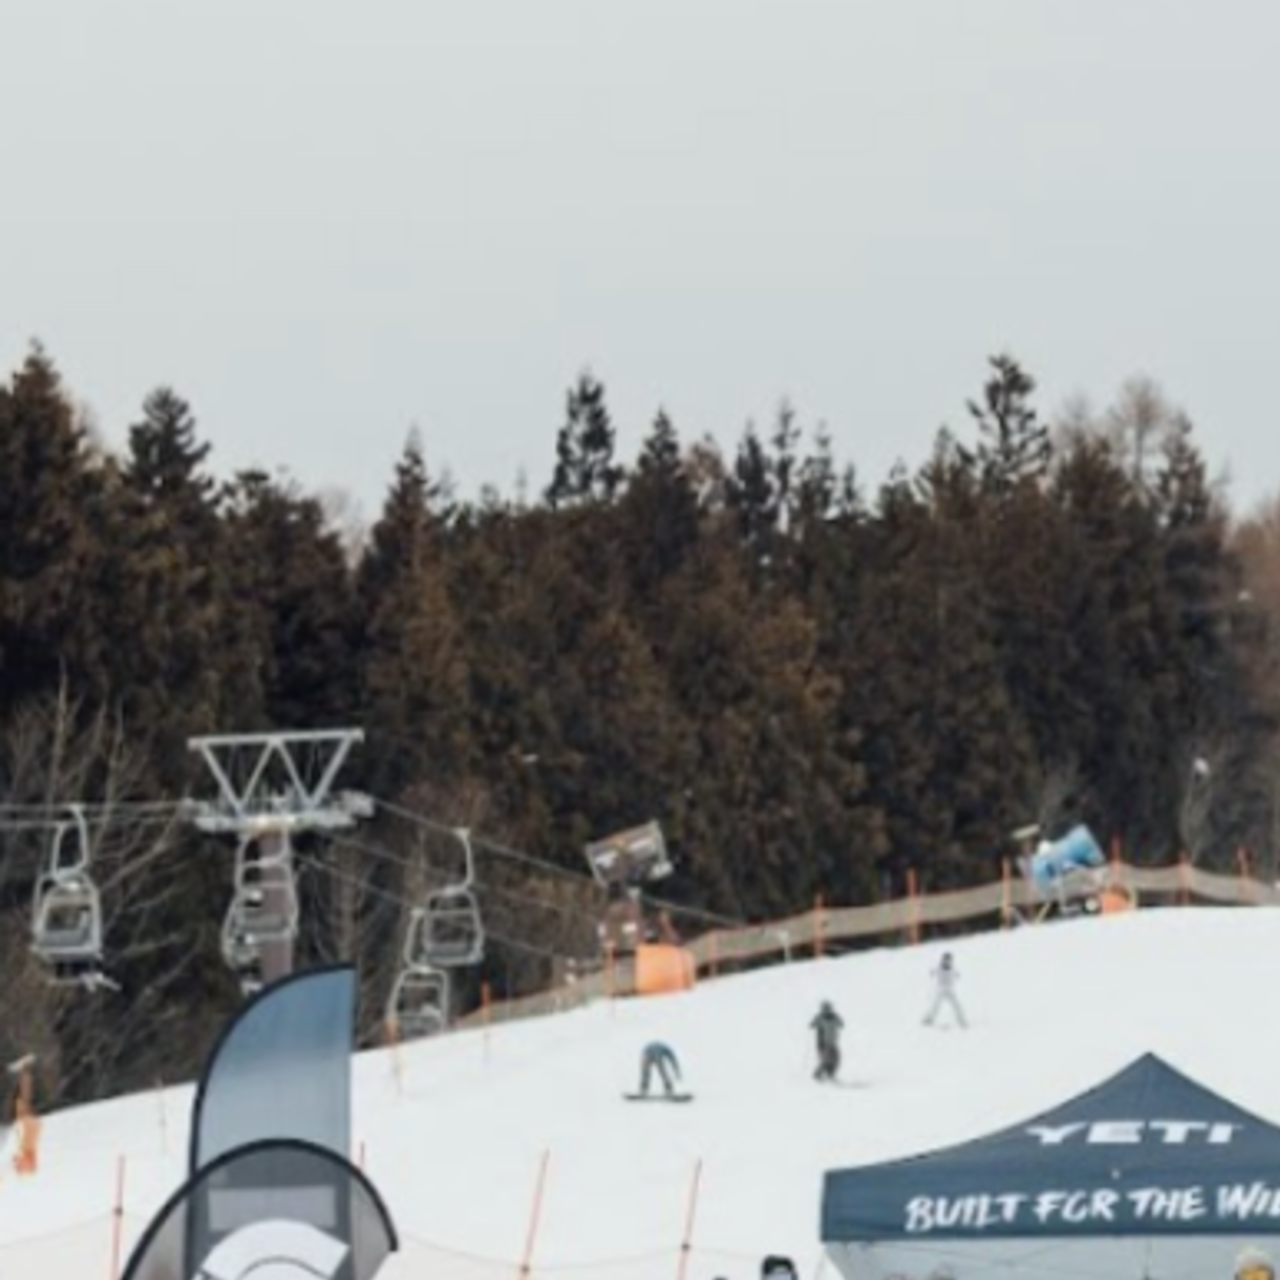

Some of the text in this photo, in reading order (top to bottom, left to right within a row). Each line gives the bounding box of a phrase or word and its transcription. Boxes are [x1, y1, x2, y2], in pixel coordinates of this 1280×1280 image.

[1025, 1119, 1237, 1145] YETI
[904, 1193, 1028, 1233] BUILT
[1033, 1188, 1121, 1225] FOR
[1126, 1185, 1207, 1221] THE
